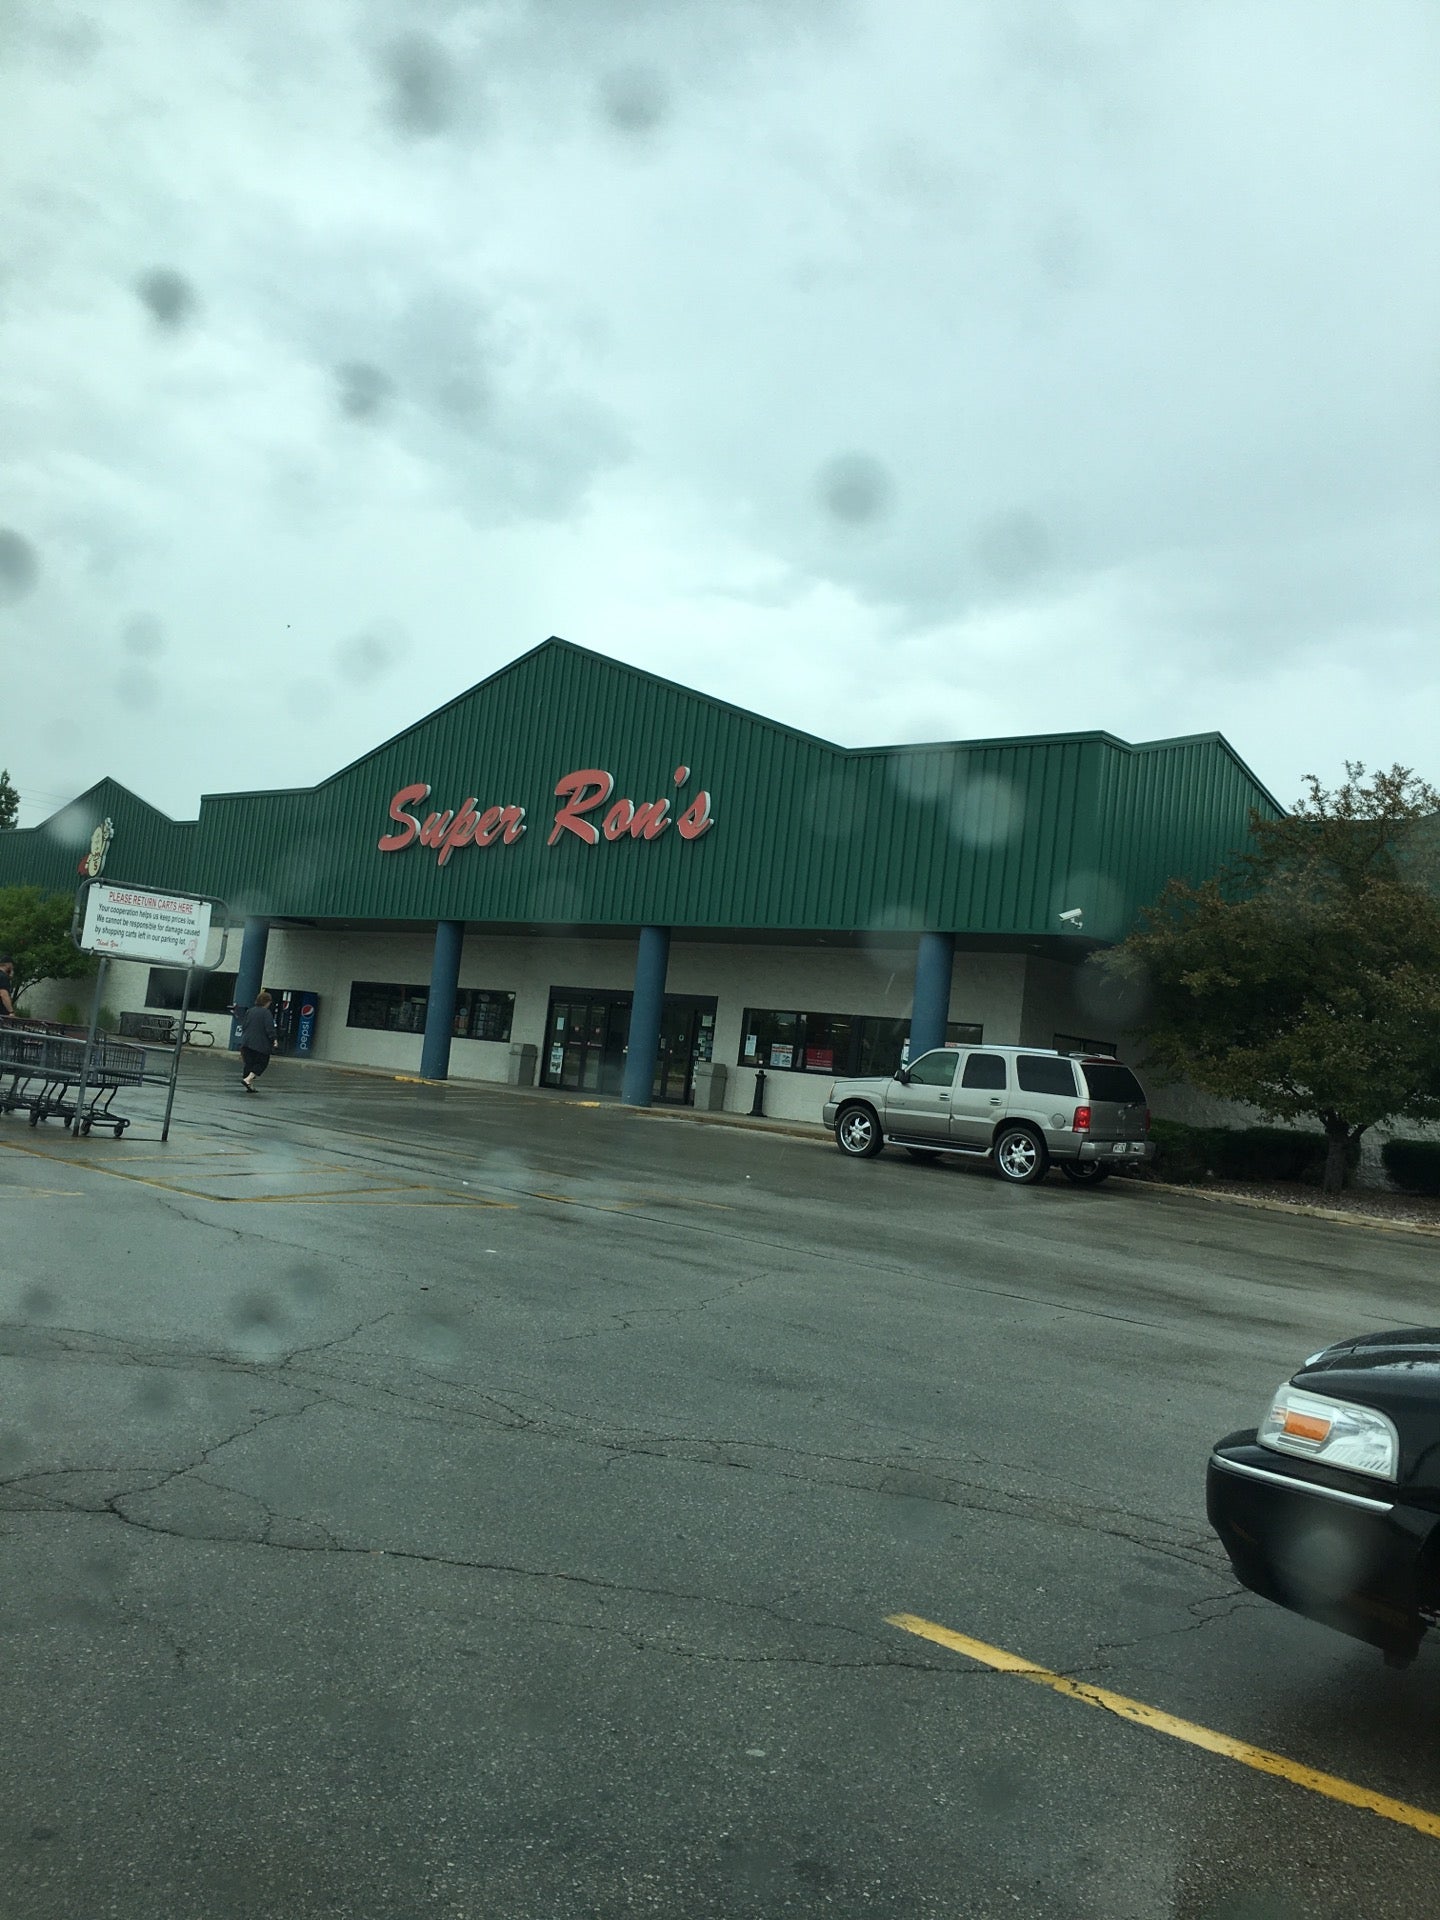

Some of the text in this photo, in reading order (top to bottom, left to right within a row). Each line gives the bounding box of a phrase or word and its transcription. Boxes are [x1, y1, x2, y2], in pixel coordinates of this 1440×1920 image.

[378, 765, 714, 866] Super Ron's
[109, 891, 193, 913] PLEASE RETURN CARTS HERE
[99, 904, 110, 912] Your
[110, 906, 139, 917] cooperation
[139, 910, 152, 919] helps
[160, 913, 171, 922] keep
[171, 916, 186, 924] prices
[95, 925, 101, 935] by
[102, 927, 124, 939] shopping
[125, 930, 137, 939] carts
[138, 931, 146, 940] left
[152, 934, 160, 942] our
[161, 935, 179, 947] parking
[97, 914, 105, 923] We
[105, 917, 122, 926] cannot
[123, 918, 129, 926] be
[130, 920, 157, 931] responsible
[165, 924, 183, 936] damage
[183, 928, 200, 937] caused
[300, 1021, 310, 1050] pepsi
